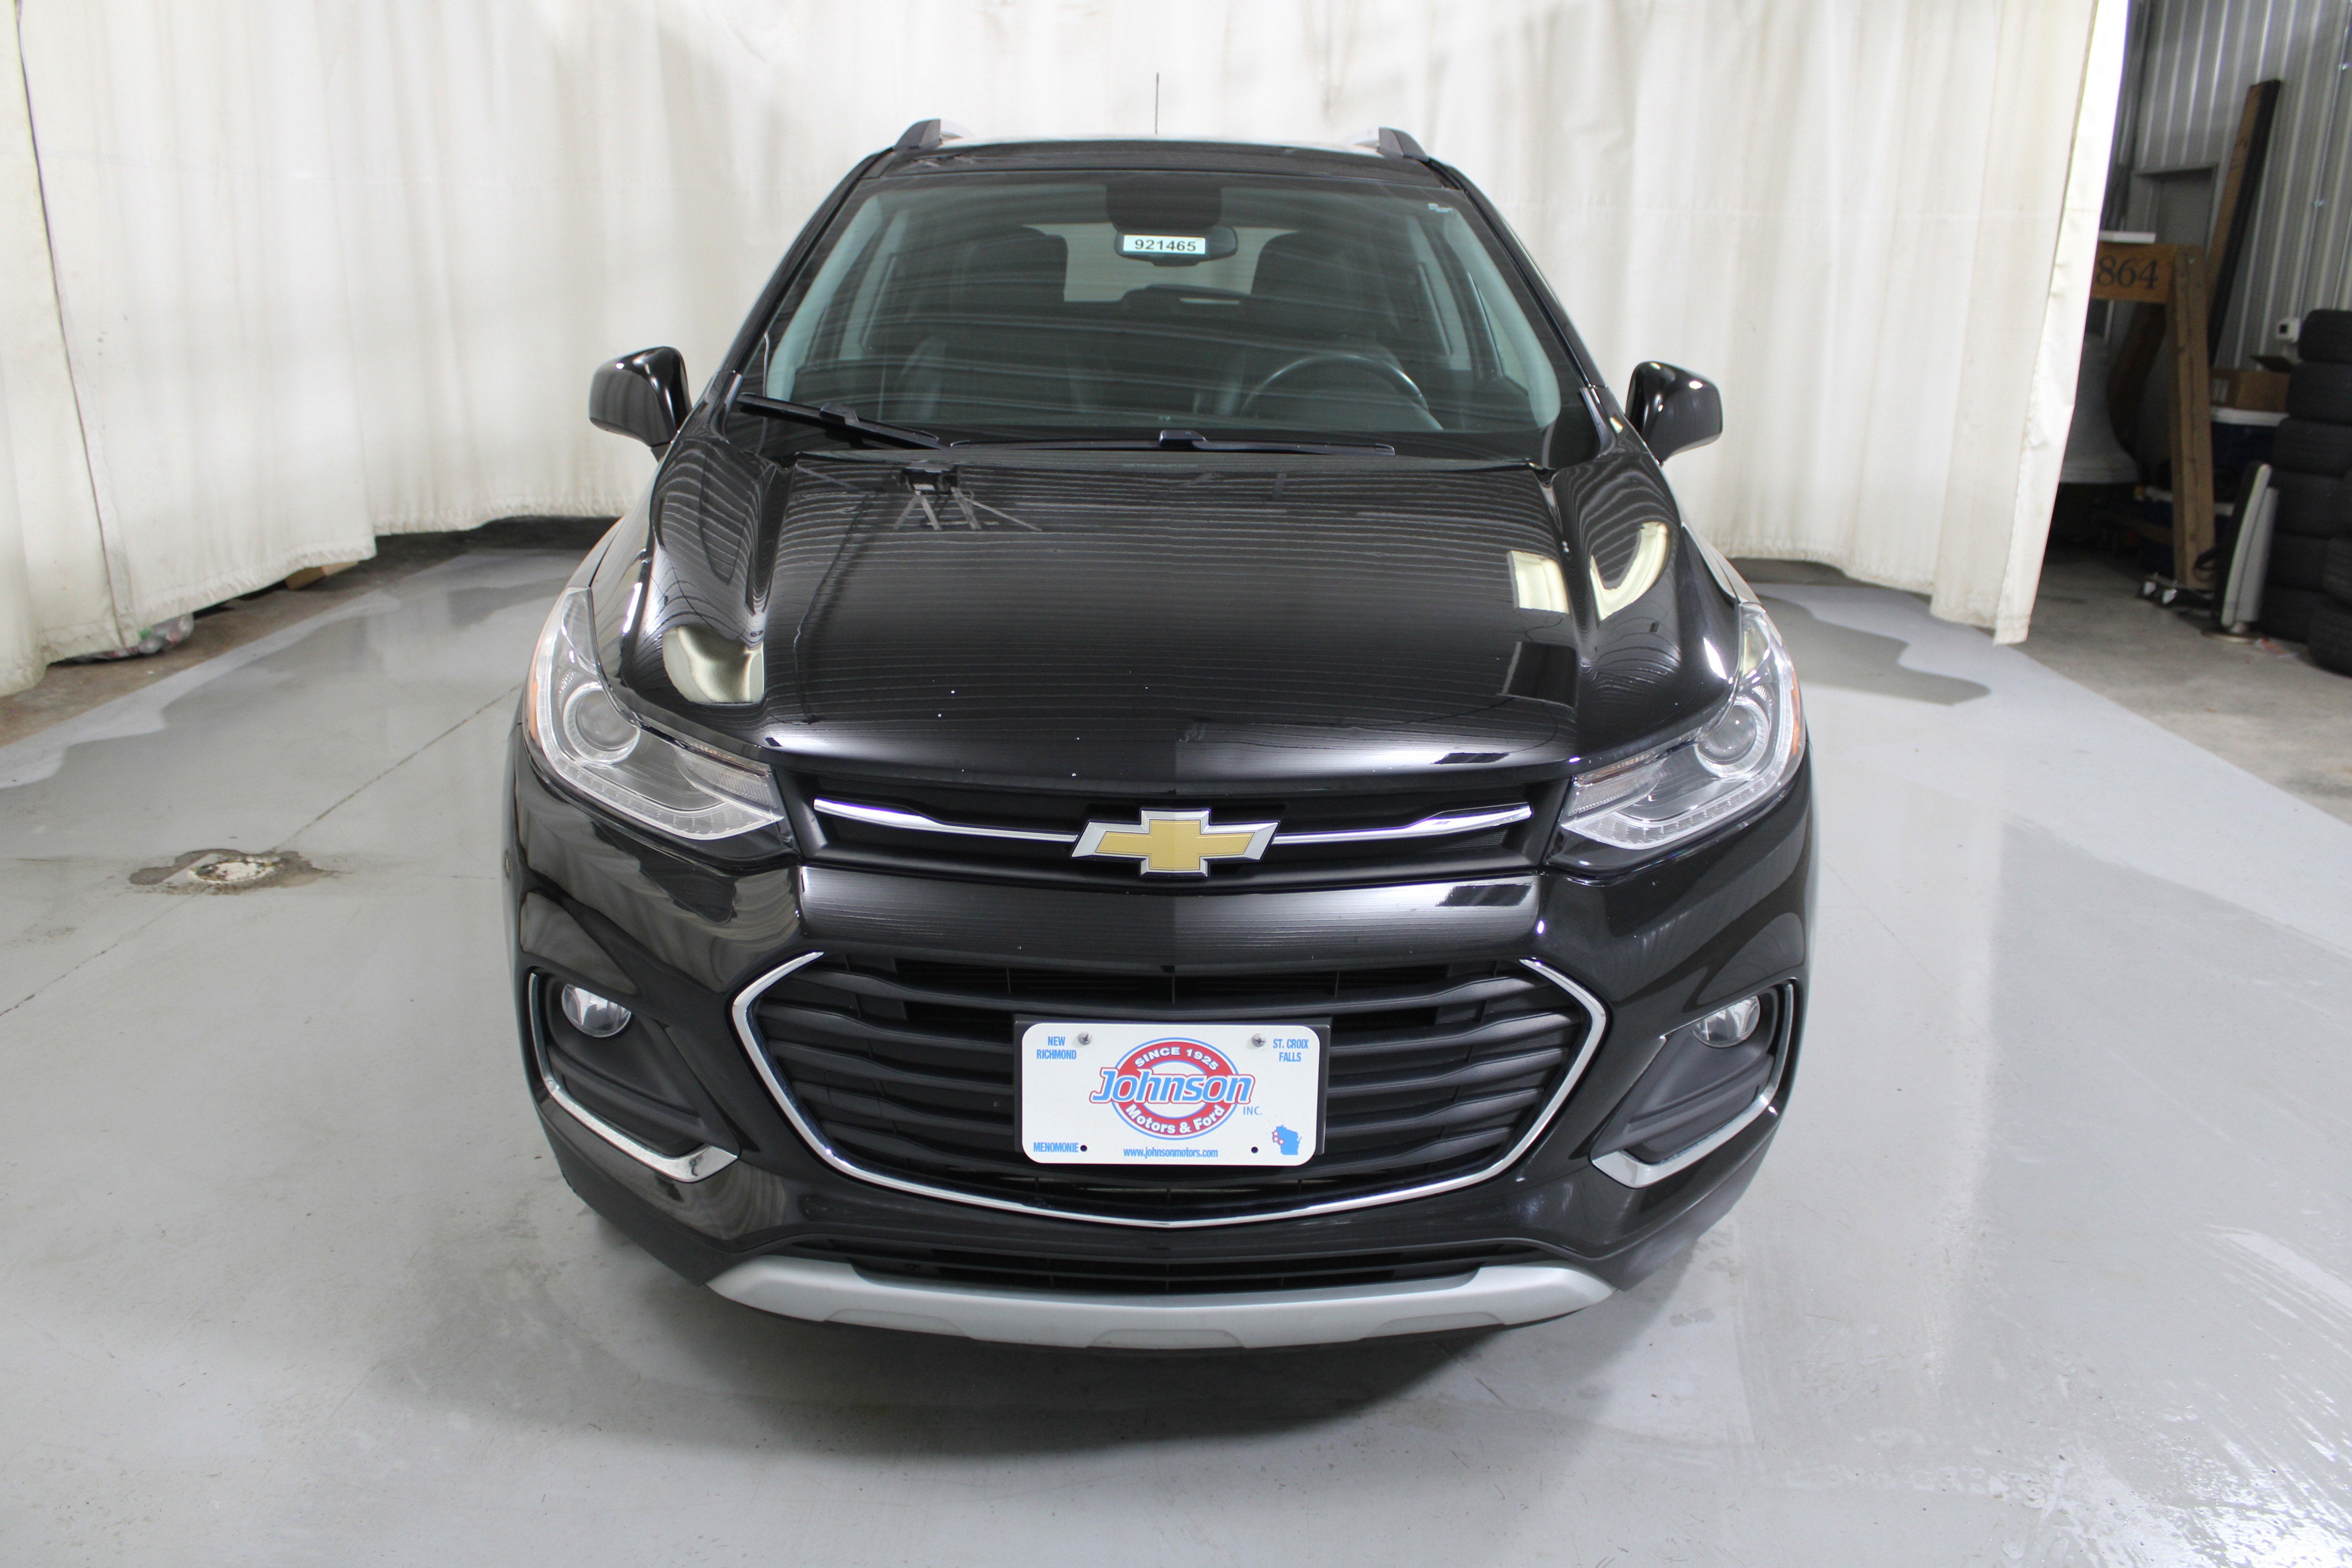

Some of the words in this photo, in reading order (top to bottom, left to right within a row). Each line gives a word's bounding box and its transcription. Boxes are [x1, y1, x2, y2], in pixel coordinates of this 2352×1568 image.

[1135, 239, 1196, 252] 921465
[2096, 255, 2159, 290] 864
[1047, 1036, 1065, 1046] NEW
[1273, 1038, 1284, 1049] ST.
[1287, 1039, 1309, 1049] CROIX
[1036, 1049, 1077, 1060] RICHMOND
[1134, 1046, 1181, 1067] SINCE
[1186, 1049, 1219, 1071] 1925
[1279, 1052, 1301, 1062] FALLS
[1092, 1070, 1253, 1102] Johnson
[1243, 1106, 1263, 1116] INC.
[1125, 1104, 1176, 1134] Motors
[1179, 1121, 1192, 1134] &
[1192, 1104, 1225, 1131] Ford
[1033, 1142, 1079, 1153] MENOMONIE
[1123, 1147, 1218, 1159] www.johnsonmotors.com
